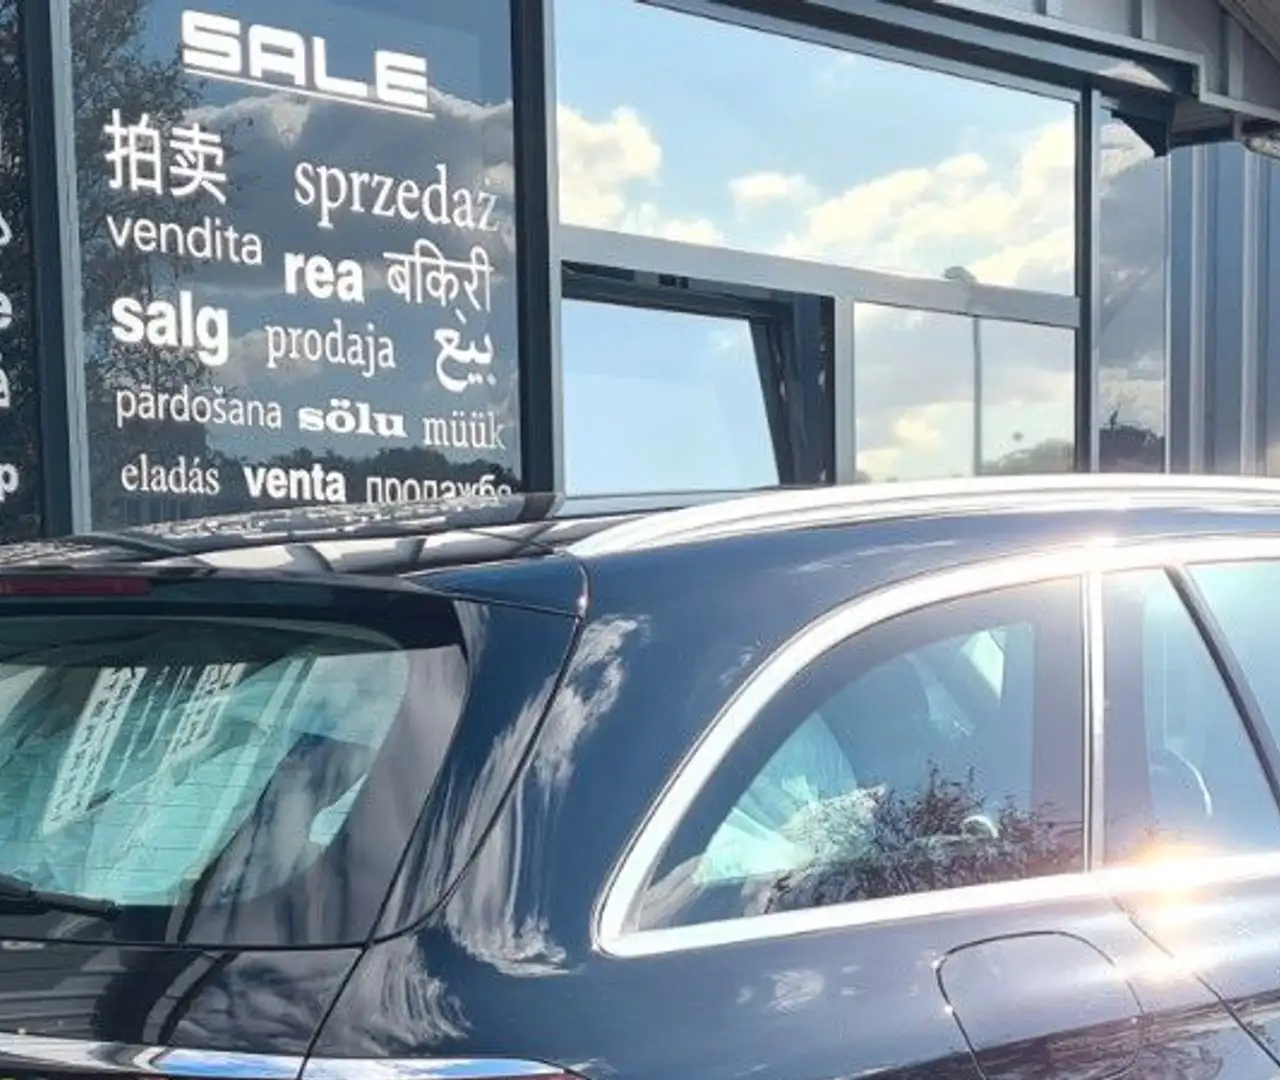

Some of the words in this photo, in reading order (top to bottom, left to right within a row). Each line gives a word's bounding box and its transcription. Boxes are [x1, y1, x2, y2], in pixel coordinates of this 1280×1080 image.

[183, 11, 428, 106] SALE
[105, 108, 226, 203] 拍卖
[108, 216, 262, 264] vendita
[285, 254, 364, 302] rea
[112, 291, 229, 366] salg
[266, 319, 395, 377] prodaja
[117, 384, 281, 429] pārdošana
[299, 399, 407, 437] sölu
[423, 411, 504, 448] müük
[122, 454, 219, 494] eladás
[244, 464, 345, 502] venta
